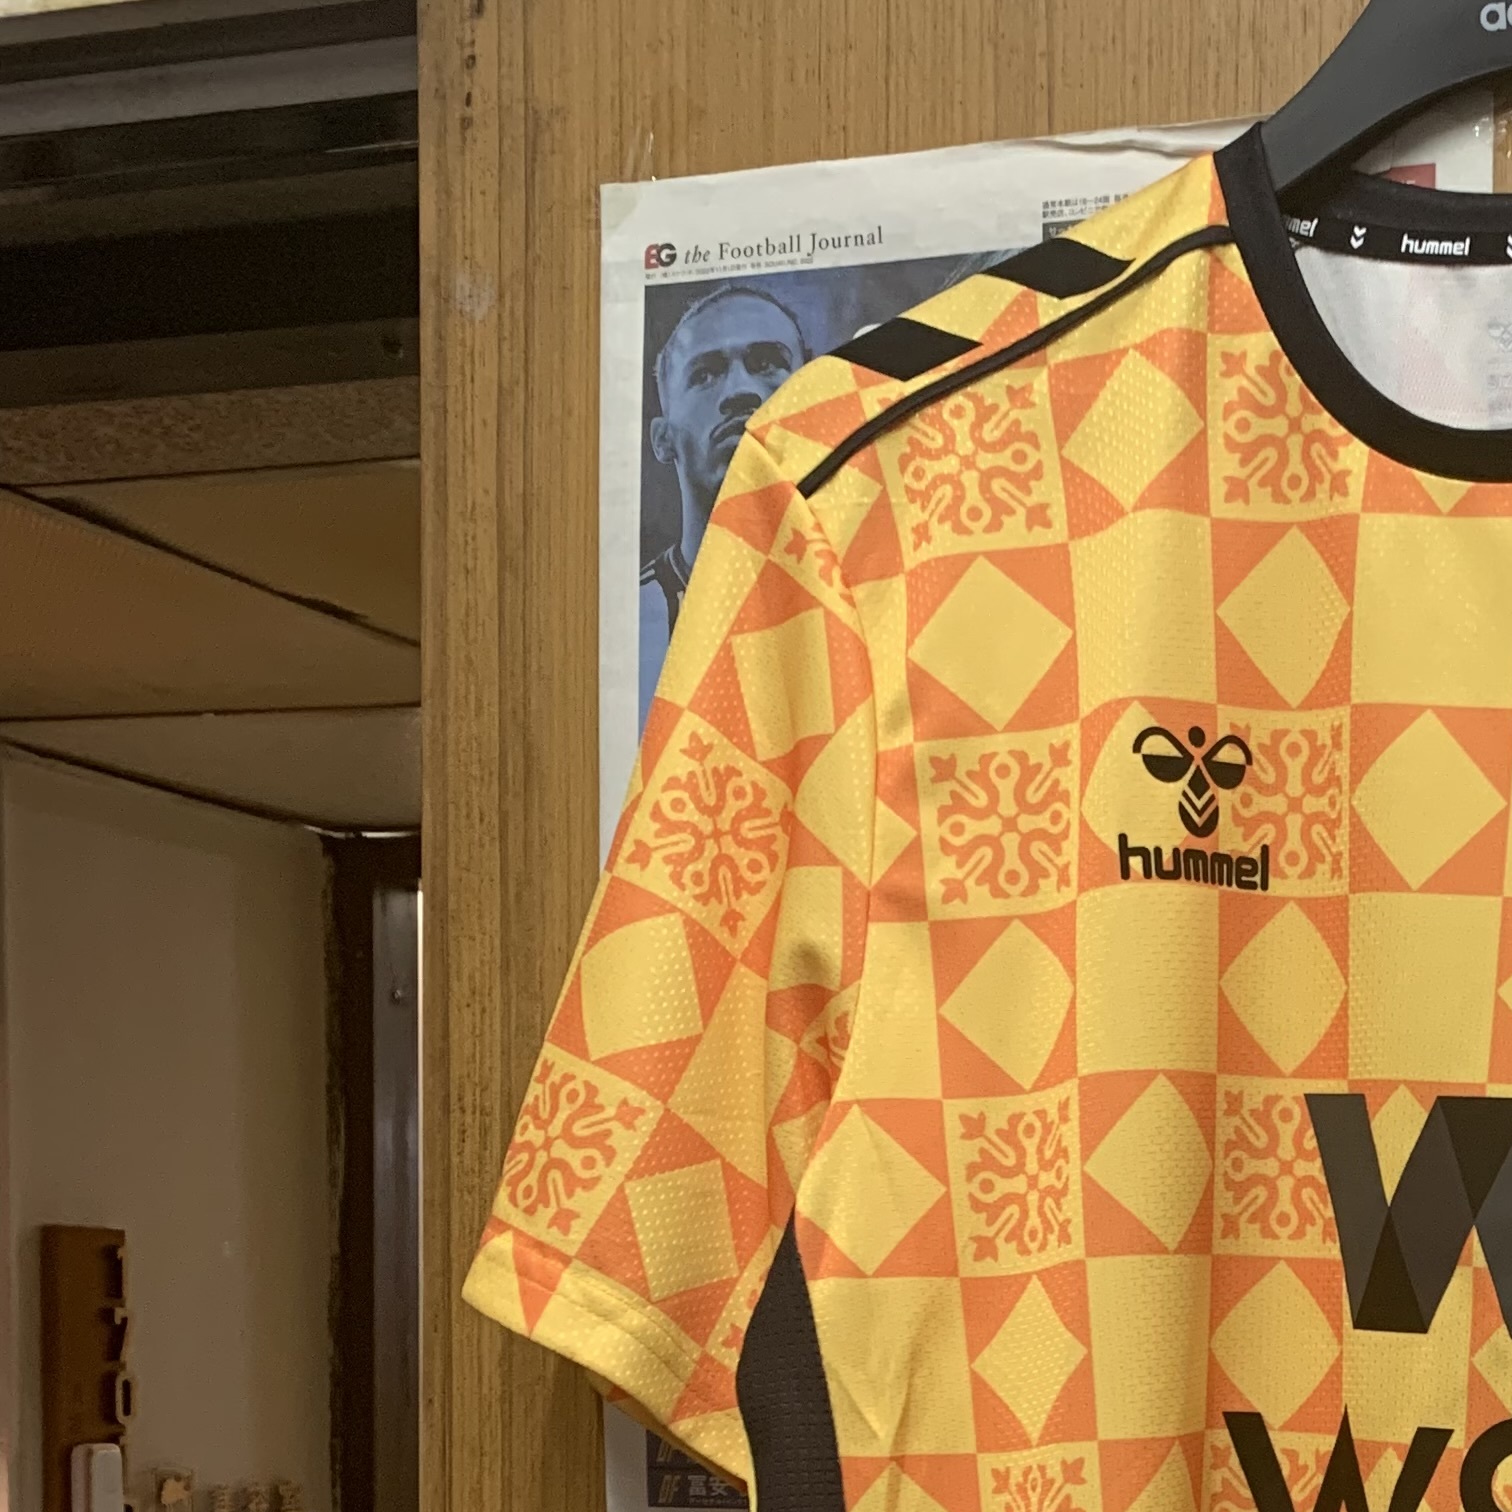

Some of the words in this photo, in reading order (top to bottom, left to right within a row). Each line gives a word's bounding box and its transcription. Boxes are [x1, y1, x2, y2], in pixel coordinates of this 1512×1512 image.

[684, 244, 711, 265] the
[718, 233, 801, 261] Football
[807, 225, 884, 257] Journal
[1401, 232, 1471, 256] hummel
[1118, 833, 1271, 892] hummel
